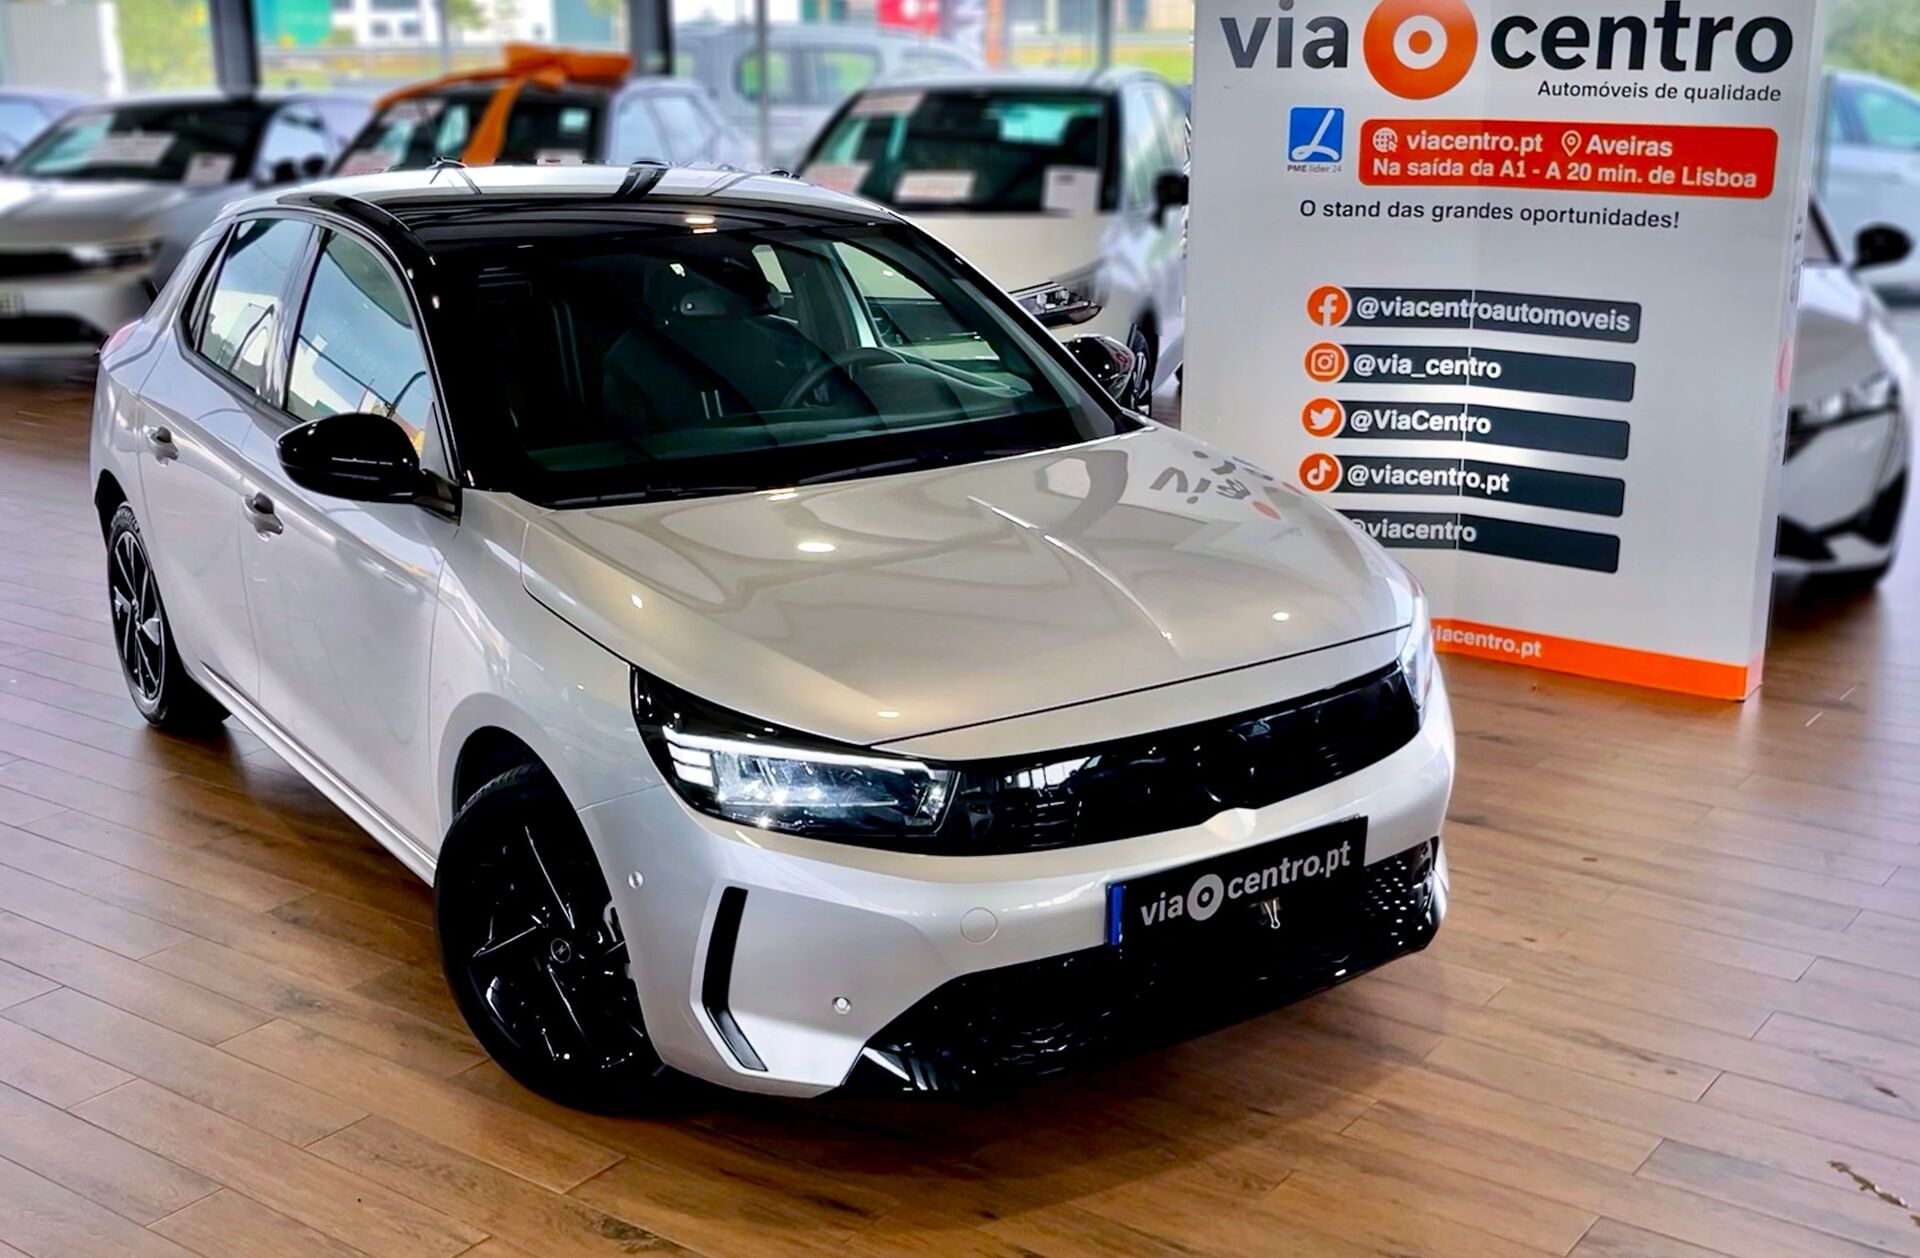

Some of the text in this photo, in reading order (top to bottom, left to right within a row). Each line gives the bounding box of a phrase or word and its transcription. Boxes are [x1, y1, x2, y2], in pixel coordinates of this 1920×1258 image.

[1219, 0, 1793, 73] via centro
[1537, 80, 1781, 103] Automóveis de qualidade
[1406, 130, 1673, 157] viacentro.pt Aveiras
[1373, 158, 1400, 176] Na
[1407, 158, 1464, 176] saída
[1470, 159, 1494, 177] da
[1499, 160, 1526, 178] A1
[1545, 161, 1561, 180] A
[1567, 163, 1592, 181] 20
[1597, 164, 1643, 183] min.
[1648, 166, 1675, 184] de
[1682, 167, 1757, 188] Lisboa
[1300, 200, 1680, 229] O stand das grandes oportunidades!
[1356, 296, 1631, 332] @viacentroautomoveis
[1353, 354, 1501, 379] @via_centro
[1350, 408, 1491, 434] @ViaCentro
[1347, 463, 1510, 494] @viacentro.pt
[1140, 840, 1351, 926] via centro.pt
